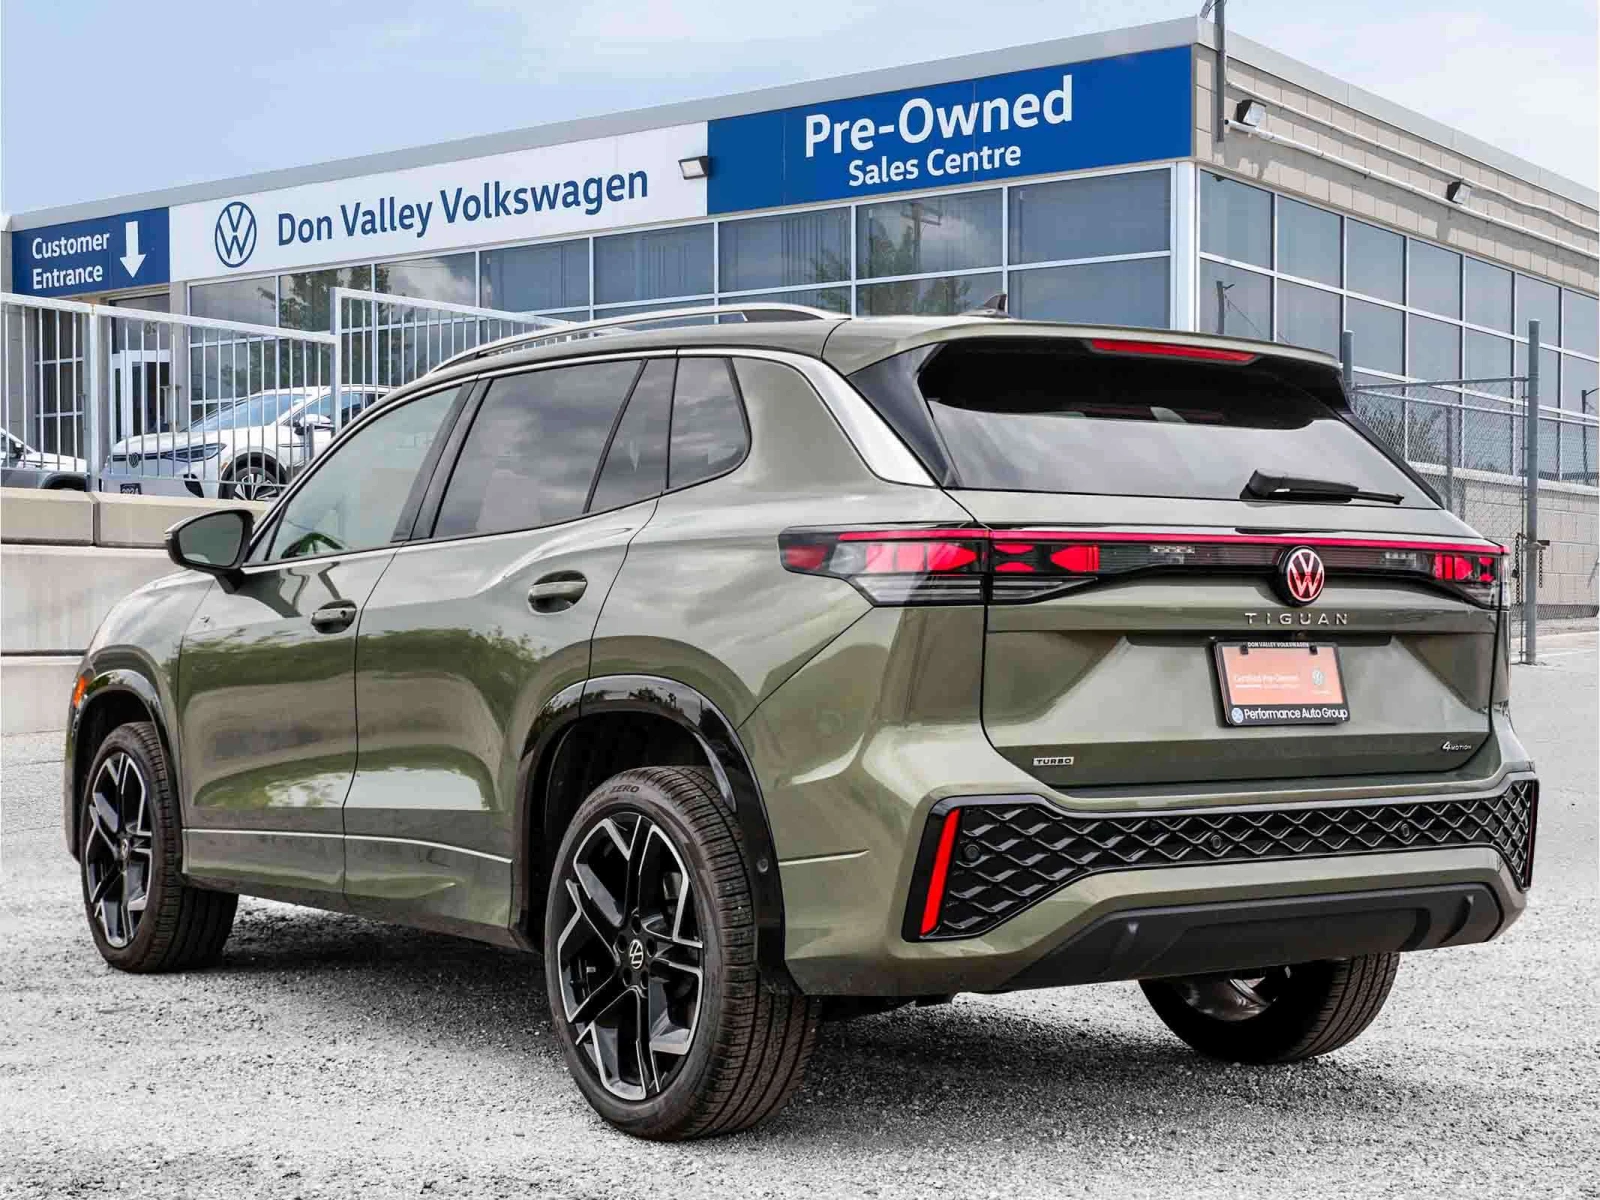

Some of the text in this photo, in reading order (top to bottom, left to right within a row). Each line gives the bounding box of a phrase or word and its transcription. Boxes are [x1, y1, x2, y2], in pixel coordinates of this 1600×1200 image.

[805, 74, 1073, 158] Pre-Owned
[849, 145, 1021, 187] Sales Centre
[278, 169, 649, 246] Don Valley Volkswagen
[32, 231, 110, 259] Customer
[33, 265, 103, 289] Entrance
[1244, 612, 1349, 625] TIGUAN
[1244, 707, 1349, 720] Performance Auto Group
[611, 784, 640, 793] ZERO
